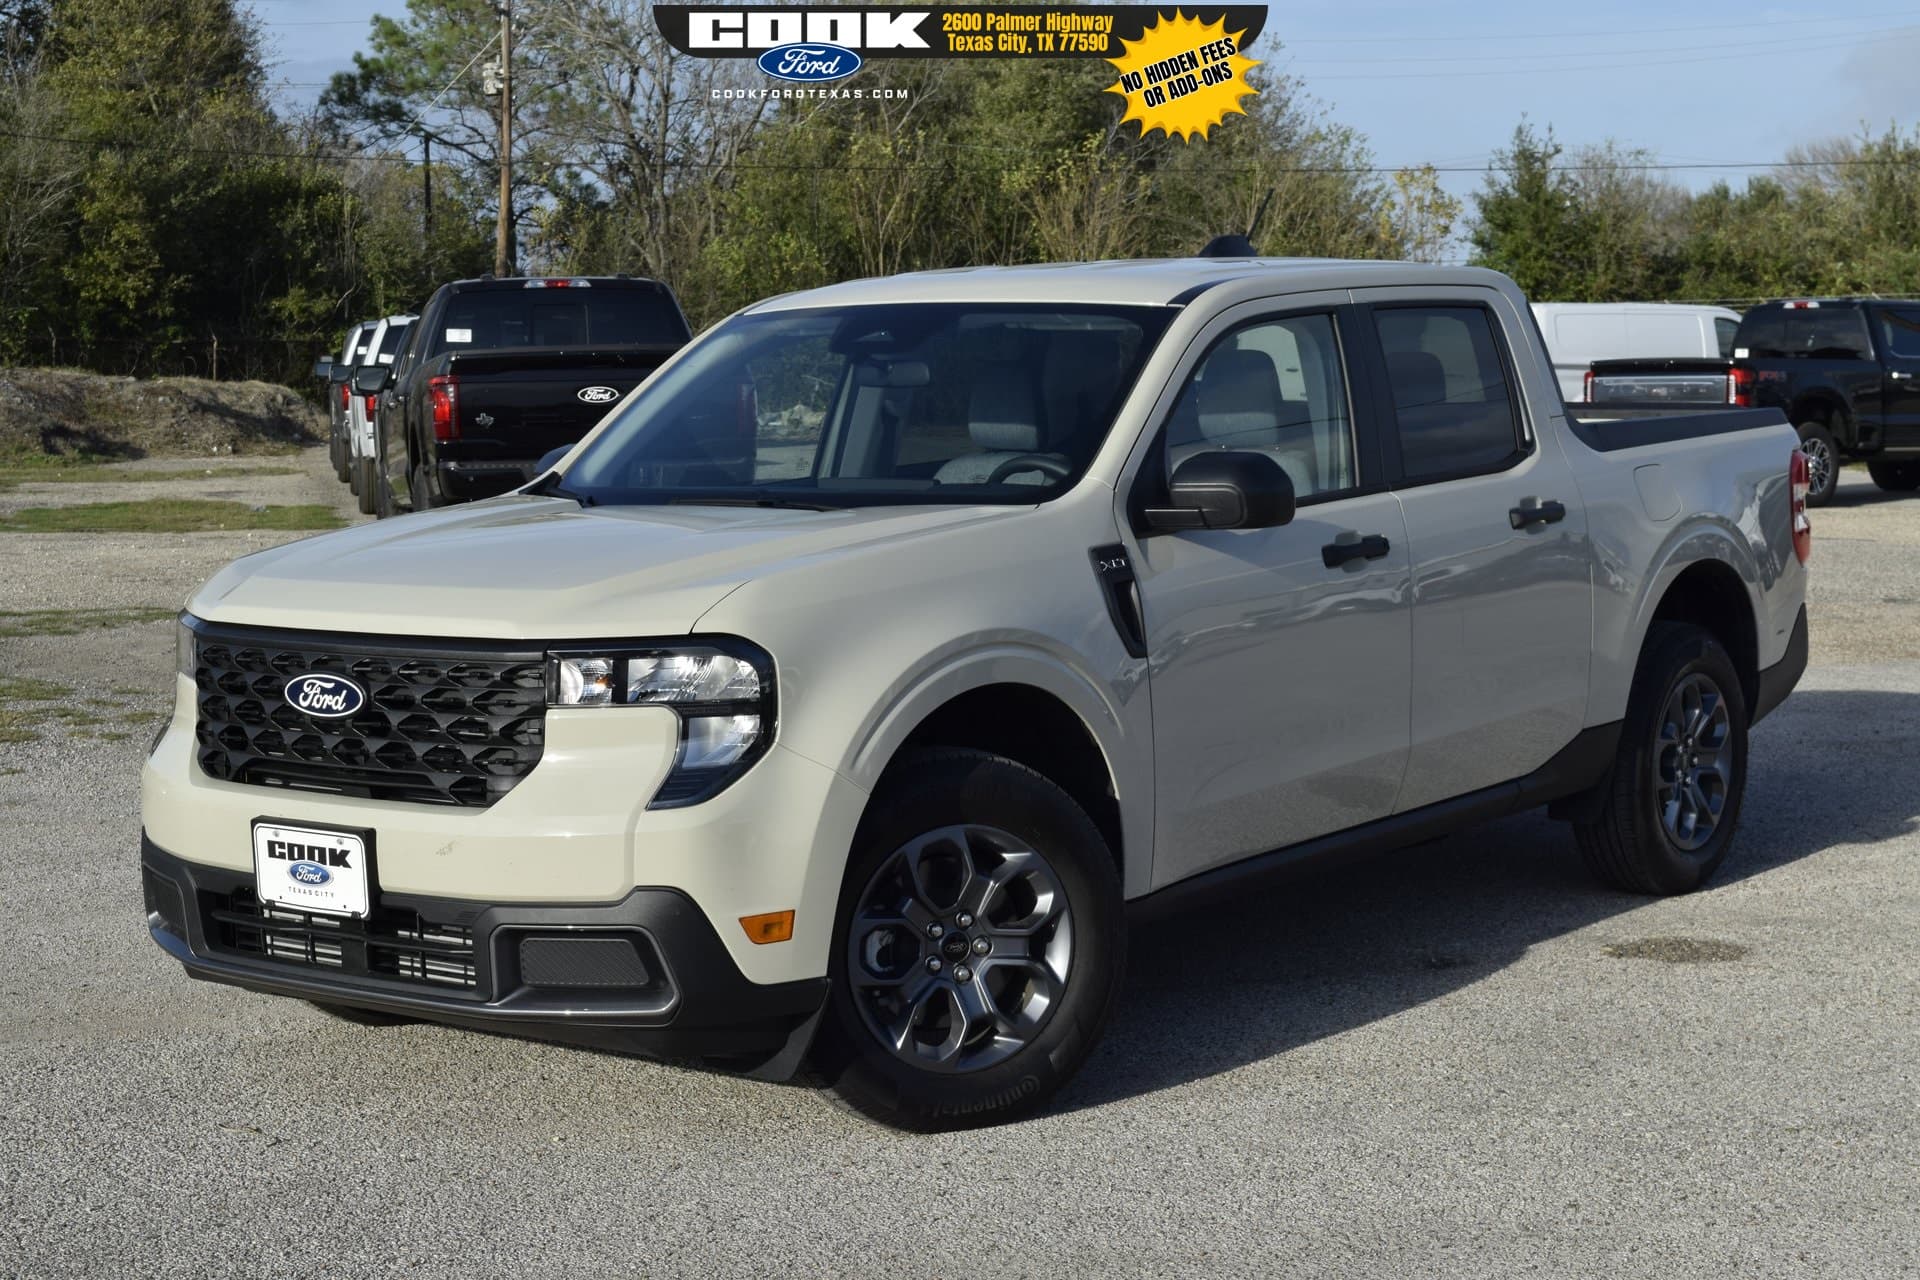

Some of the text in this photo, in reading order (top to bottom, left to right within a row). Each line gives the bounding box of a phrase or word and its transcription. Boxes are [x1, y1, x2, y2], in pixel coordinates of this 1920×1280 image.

[299, 679, 347, 711] Ford
[267, 840, 352, 869] COOK
[296, 865, 322, 883] Ford
